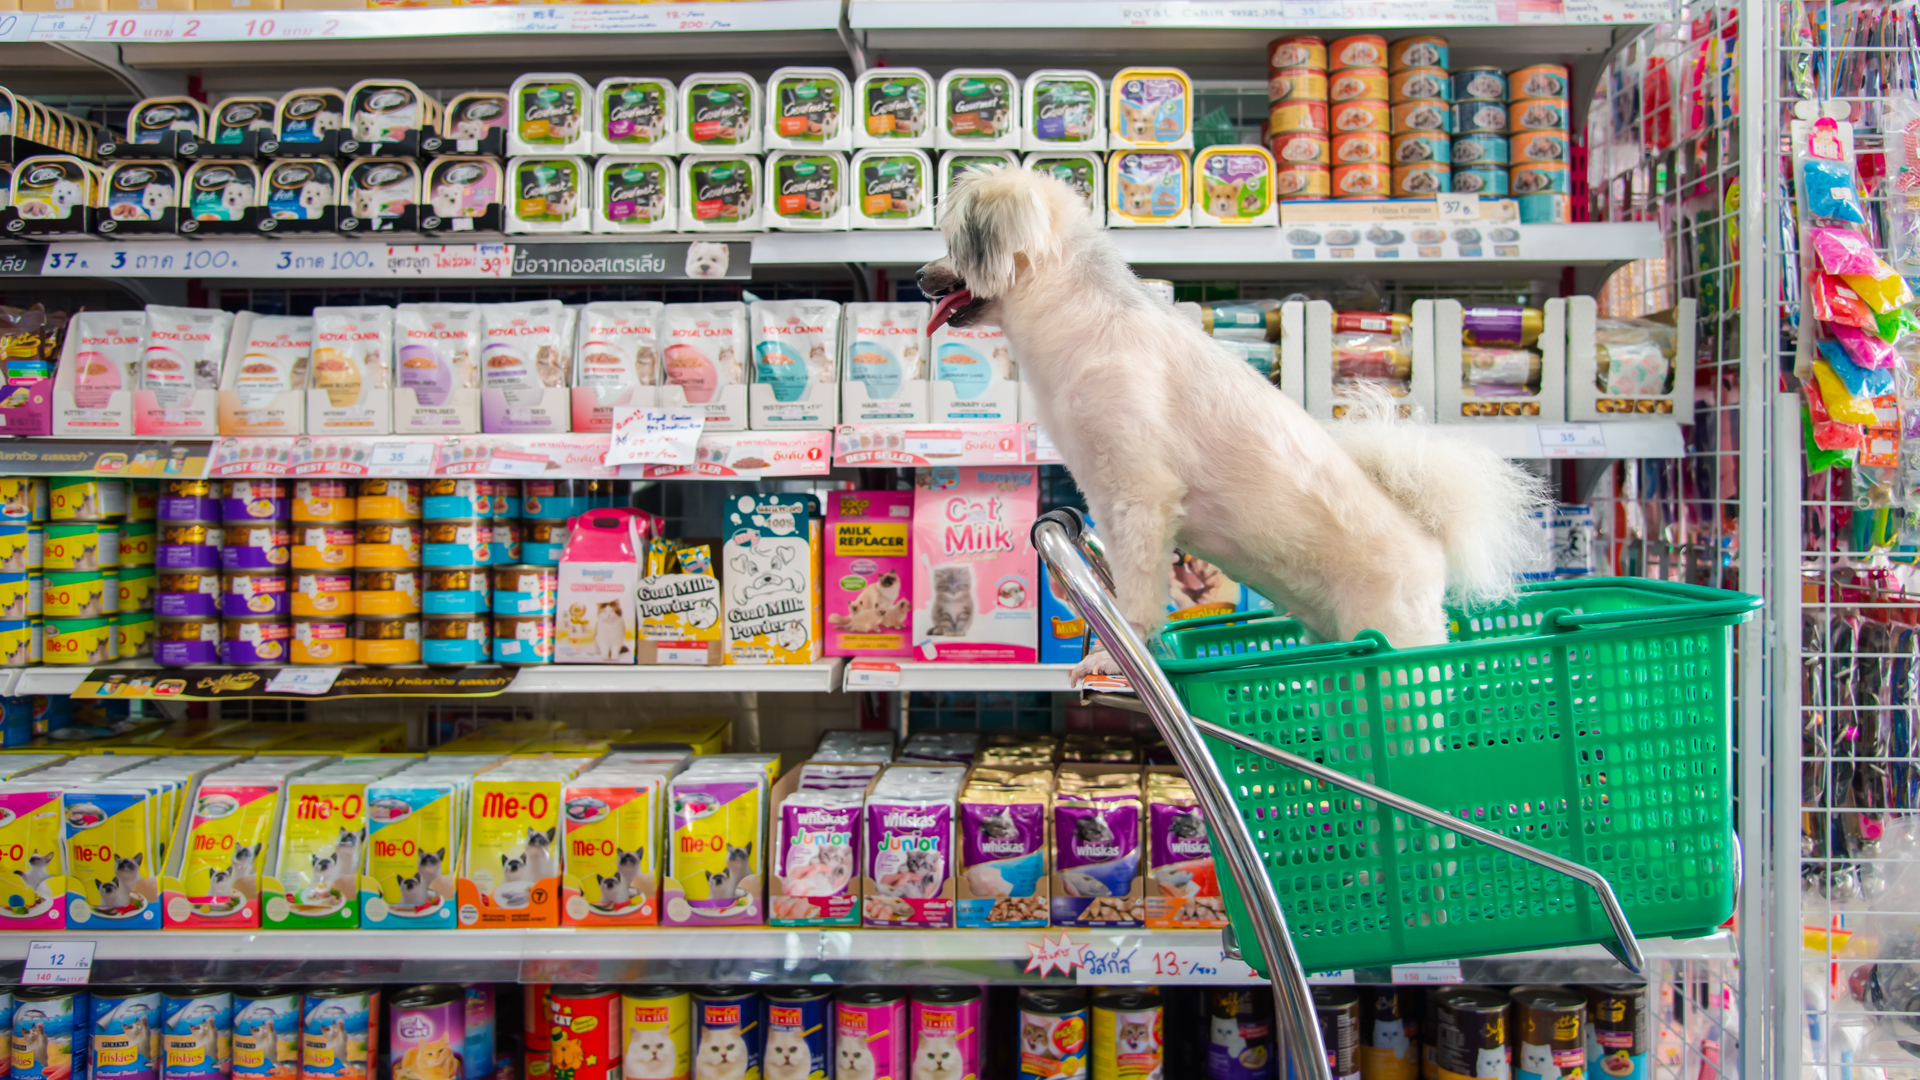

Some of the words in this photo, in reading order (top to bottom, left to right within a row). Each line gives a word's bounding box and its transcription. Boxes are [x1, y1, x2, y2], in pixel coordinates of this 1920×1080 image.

[105, 19, 137, 37] 10
[182, 19, 201, 37] 2
[244, 19, 275, 36] 10
[955, 98, 998, 113] Gourmet
[1372, 206, 1398, 215] Felina
[1400, 206, 1432, 215] Canino
[50, 252, 78, 268] 37
[111, 251, 128, 269] 3
[183, 250, 230, 270] 100
[277, 251, 292, 270] 3
[151, 331, 180, 342] ROYAL
[182, 332, 211, 342] CANIN
[319, 332, 348, 341] ROYAL
[351, 332, 380, 340] CANIN
[408, 330, 436, 338] ROYAL
[439, 330, 468, 339] CANIN
[488, 328, 518, 337] ROYAL
[520, 325, 550, 336] CANIN
[590, 326, 618, 336] ROYAL
[622, 326, 651, 336] CANIN
[672, 328, 702, 338] ROYAL
[704, 328, 733, 337] CANIN
[794, 326, 824, 334] CANIN
[858, 326, 886, 336] ROYAL
[889, 326, 918, 335] CANIN
[82, 336, 110, 345] ROYAL
[250, 340, 280, 348] ROYAL
[1560, 432, 1576, 442] 35
[845, 451, 873, 464] BEST
[874, 451, 914, 464] SELLER
[221, 462, 248, 474] BEST
[250, 462, 287, 475] SELLER
[296, 464, 322, 474] BEST
[325, 463, 362, 475] SELLER
[446, 462, 478, 474] BEST
[654, 465, 684, 477] BEST
[688, 463, 722, 476] SELLER
[840, 500, 870, 508] COCO
[946, 496, 998, 523] Cat
[766, 518, 795, 528] 100%
[838, 526, 871, 536] MILK
[839, 536, 904, 546] REPLACER
[946, 524, 1010, 552] Milk
[638, 584, 673, 601] Goat
[675, 577, 714, 597] Milk
[640, 600, 696, 618] Powder
[728, 605, 766, 623] Goat
[767, 597, 805, 616] Milk
[731, 619, 784, 640] Powder
[1056, 622, 1080, 634] Milk
[46, 639, 78, 652] Me-O
[297, 794, 362, 820] Me-O
[482, 792, 548, 819] Me-O
[798, 812, 849, 826] whiskas
[884, 812, 936, 828] whiskas
[194, 834, 234, 850] Me-O
[792, 827, 850, 846] Junior
[878, 832, 940, 852] Junior
[374, 840, 416, 858] Me-O
[572, 840, 614, 857] Me-O
[681, 835, 724, 852] Me-O
[982, 840, 1025, 854] whiskas
[1172, 842, 1211, 854] whiska
[74, 844, 112, 862] Me-O
[1076, 845, 1120, 857] whiskas
[50, 954, 65, 966] 12
[36, 973, 52, 982] 140
[404, 1028, 428, 1038] Cat
